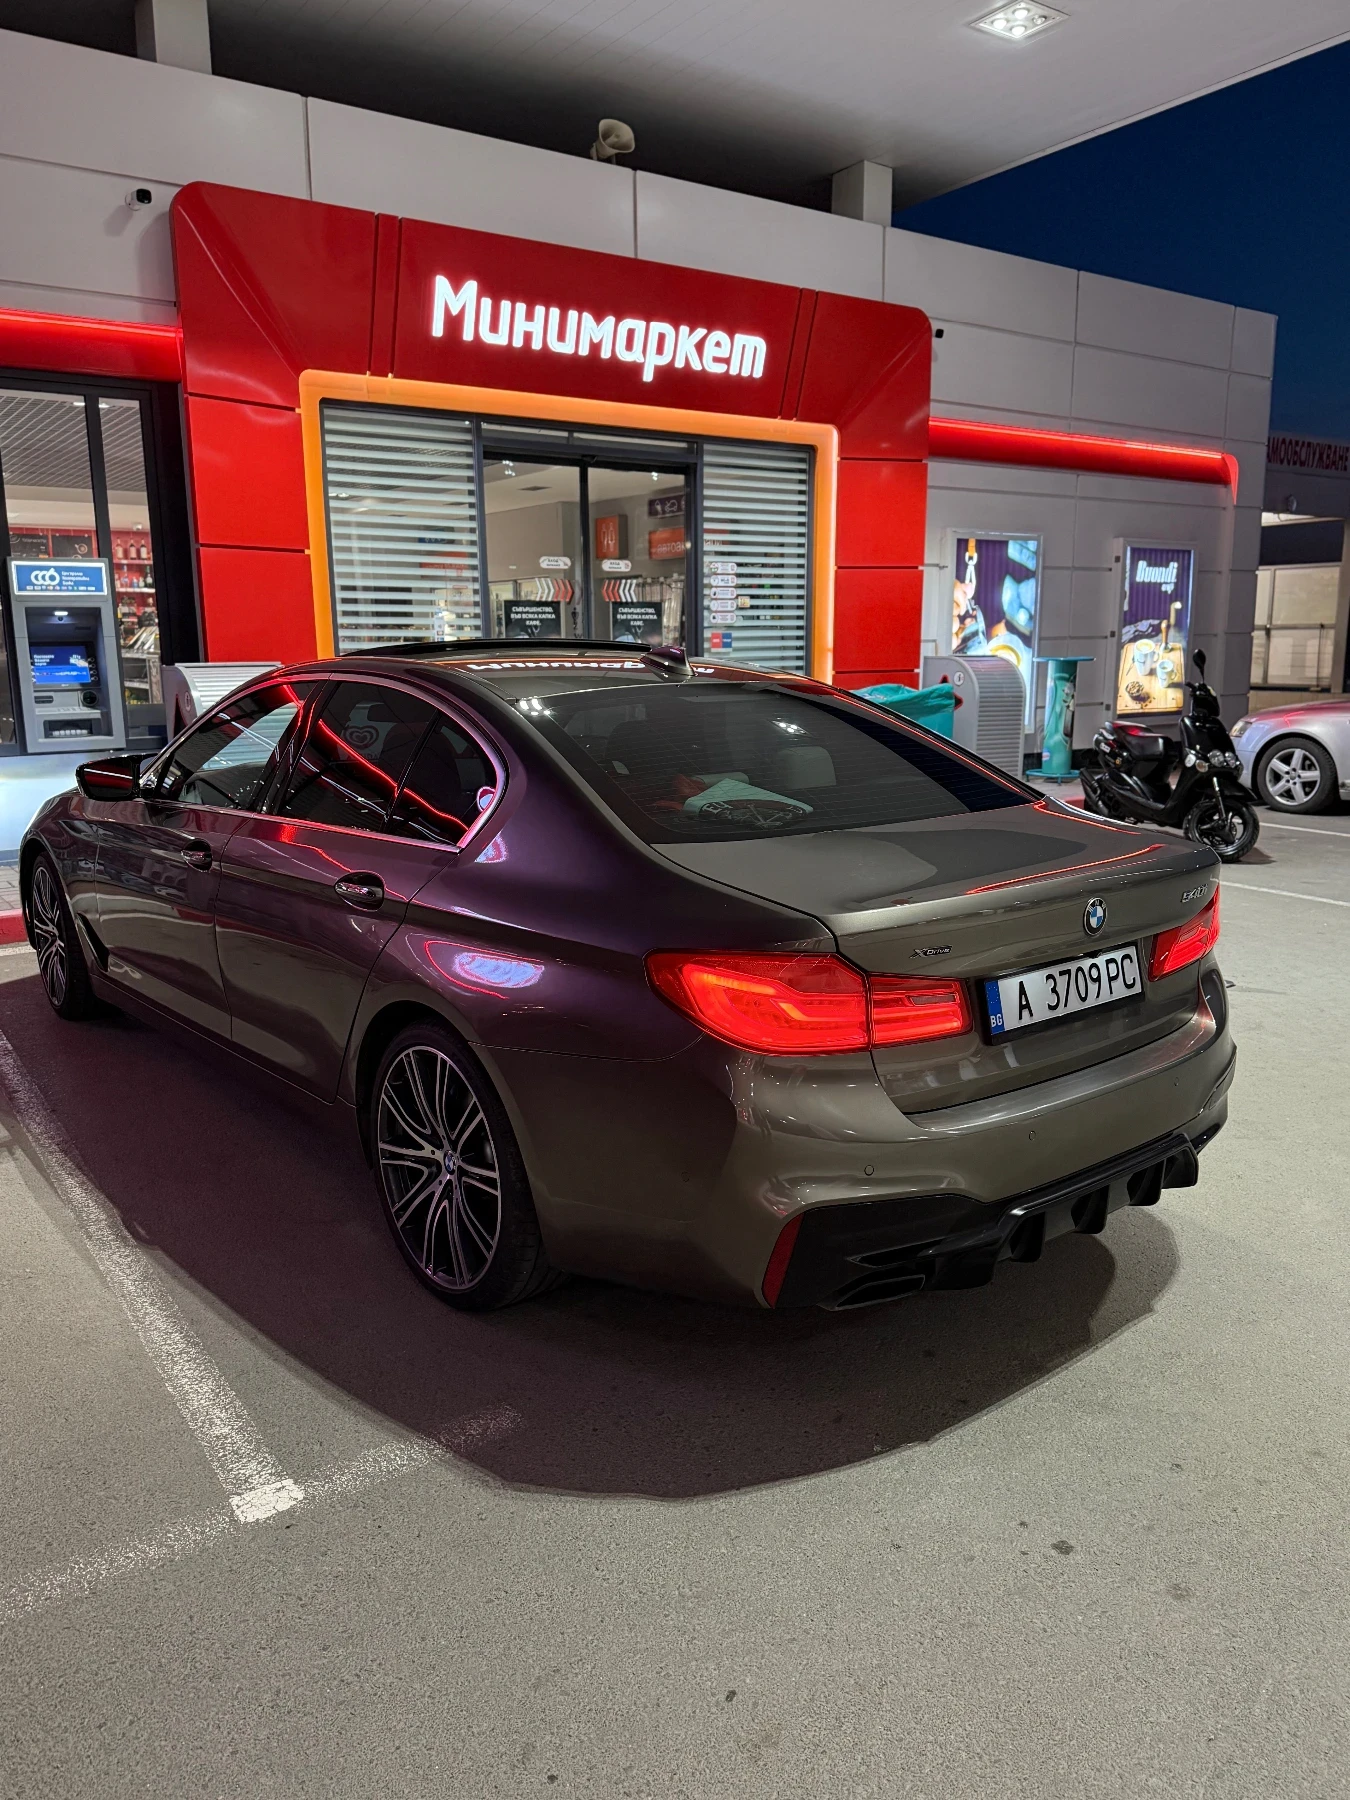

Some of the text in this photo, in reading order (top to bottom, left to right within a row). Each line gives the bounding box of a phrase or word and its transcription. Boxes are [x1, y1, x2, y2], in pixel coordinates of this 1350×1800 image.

[432, 275, 766, 382] Минимаркет
[1136, 560, 1178, 583] Buondi
[1018, 981, 1033, 1020] A
[990, 1014, 1003, 1028] BG
